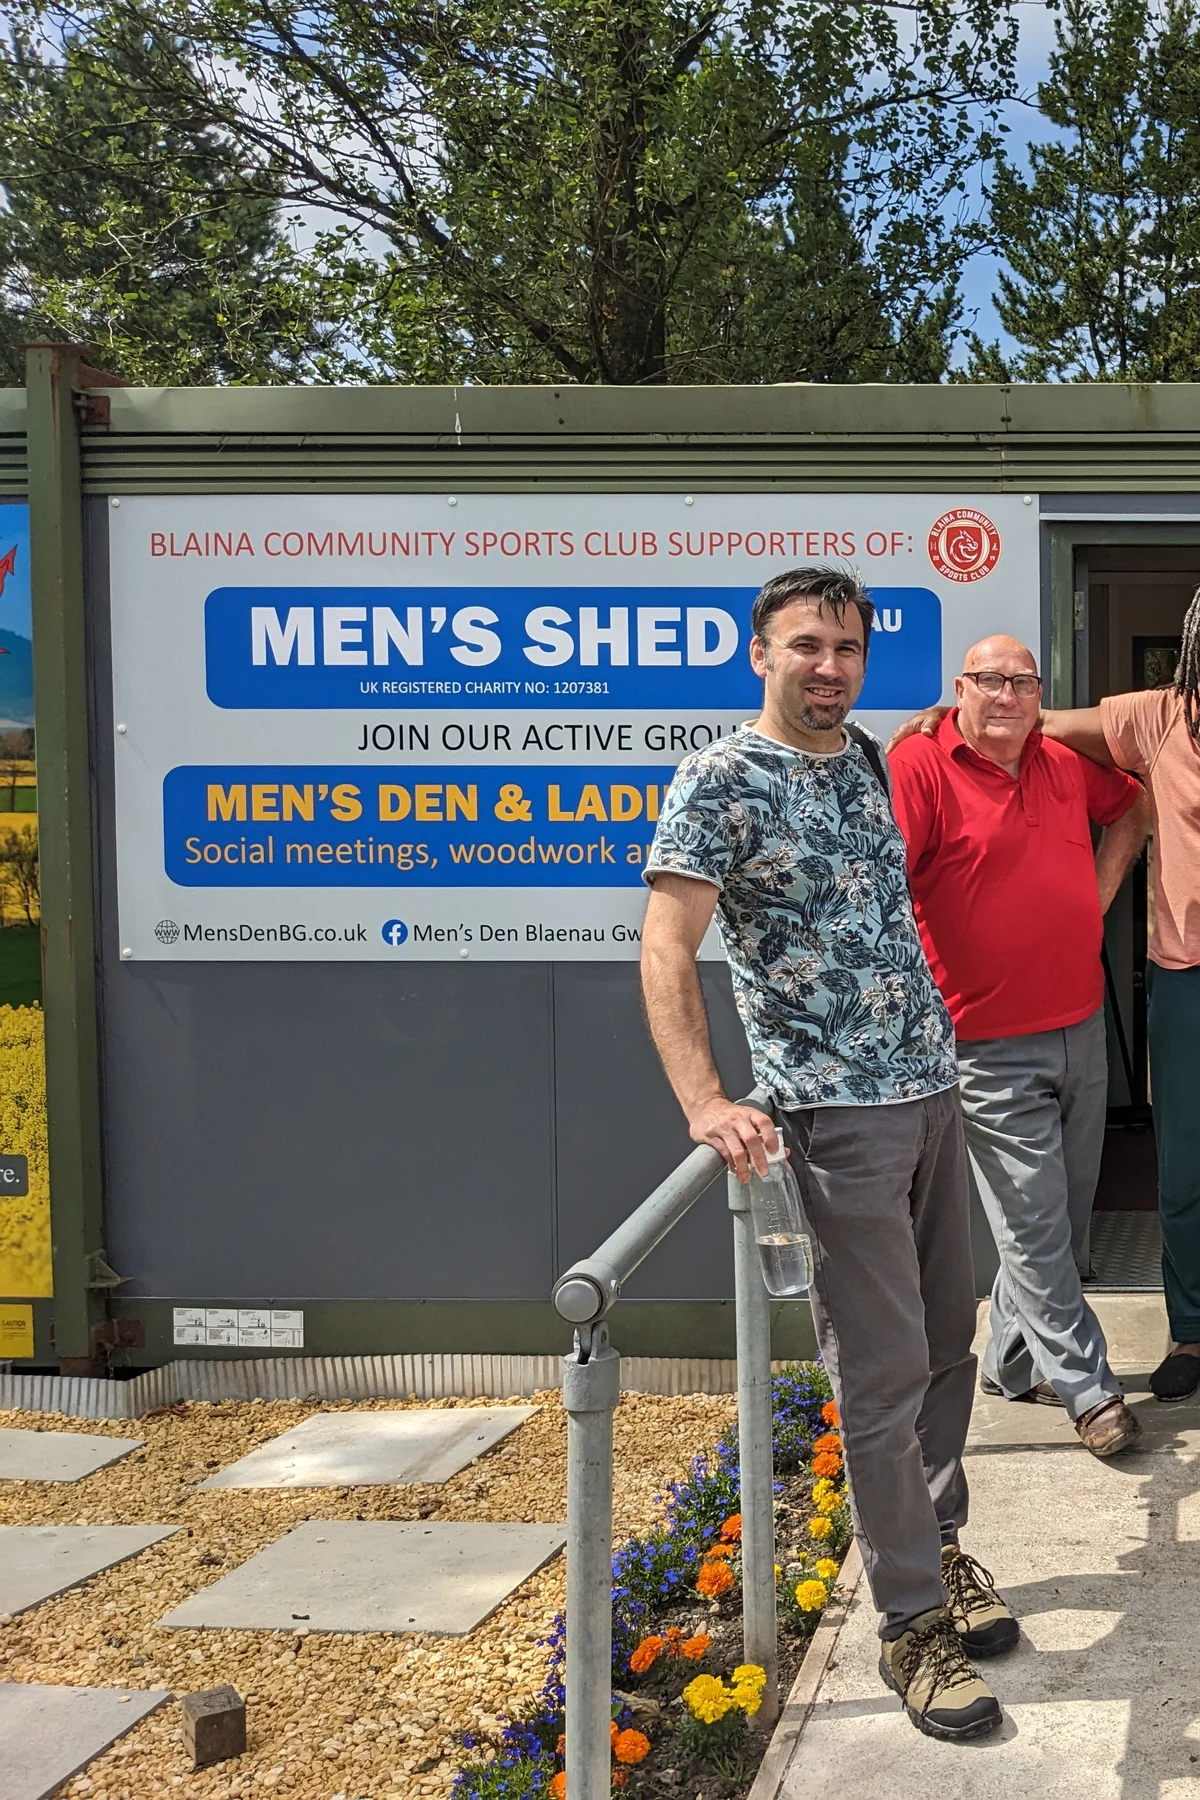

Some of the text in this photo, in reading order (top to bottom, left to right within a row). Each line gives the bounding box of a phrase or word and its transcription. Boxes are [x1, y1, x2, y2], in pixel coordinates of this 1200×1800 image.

[931, 510, 998, 537] BLAINA COMMUNITY
[151, 532, 914, 557] BLAINA COMMUNITY SPORTS CLUB SUPPORTERS OF:
[939, 564, 990, 581] SPORTS CLUB
[251, 606, 739, 667] MEN’S SHED
[360, 681, 610, 694] UK REGISTERED CHARITY NO: 1207381
[357, 724, 430, 751] JOIN
[441, 724, 512, 751] OUR
[521, 724, 633, 751] ACTIVE
[206, 784, 669, 822] MEN’S DEN & LADI
[185, 836, 275, 865] Social
[285, 836, 438, 871] meetings,
[448, 836, 616, 865] woodwork
[183, 923, 368, 942] MensDenBG.co.uk
[413, 923, 641, 942] Men’s Den Blaenau Gw
